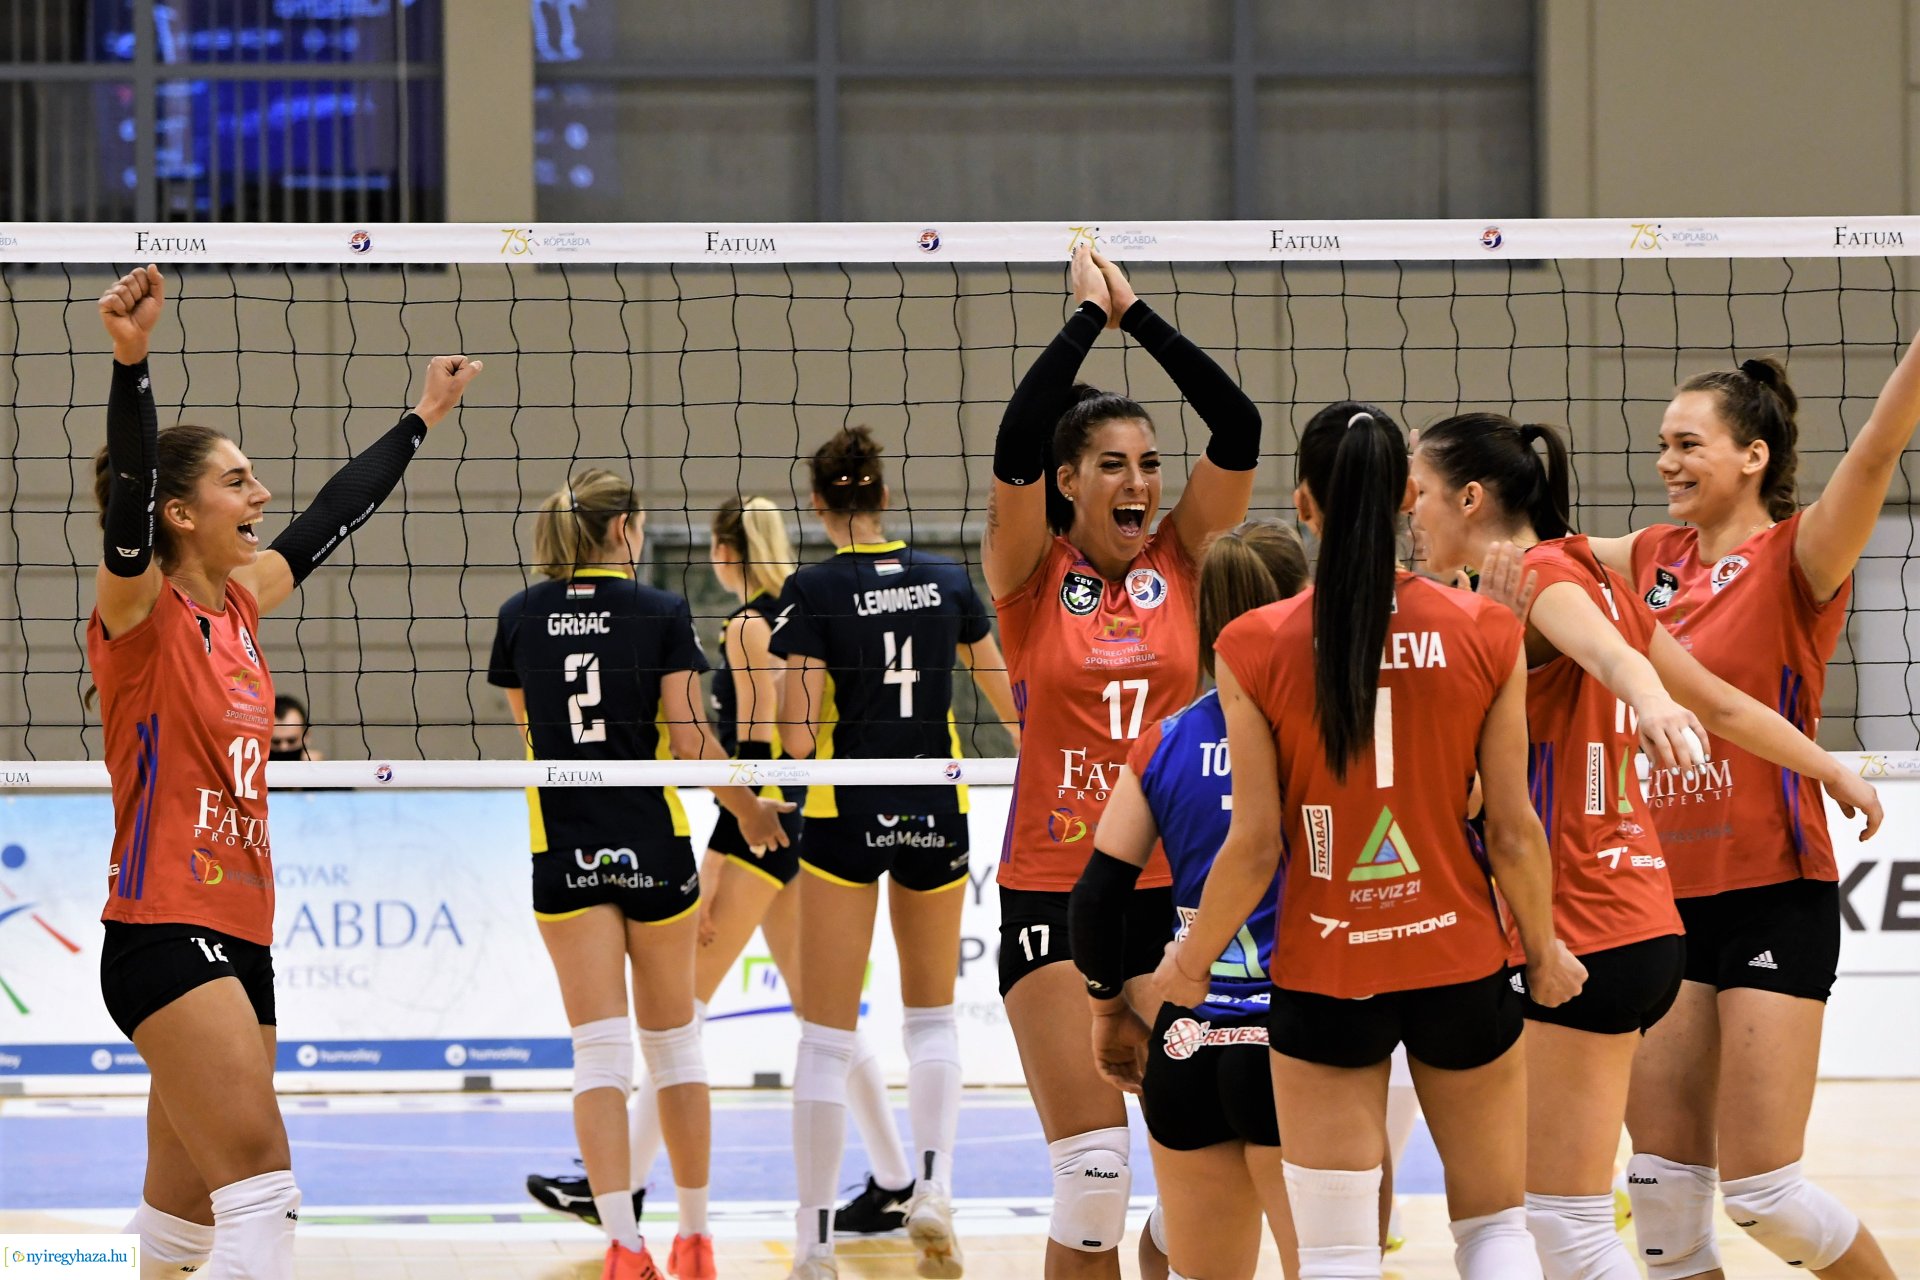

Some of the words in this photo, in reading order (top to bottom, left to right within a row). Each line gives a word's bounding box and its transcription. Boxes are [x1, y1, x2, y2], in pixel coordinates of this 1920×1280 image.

[134, 231, 207, 251] FATUM
[705, 231, 776, 251] FATUM
[1269, 229, 1340, 249] FATUM
[1834, 226, 1904, 246] FATUM
[1074, 576, 1093, 586] CEV
[853, 582, 942, 616] LEMMENS
[547, 611, 611, 636] GRBAC
[1085, 653, 1156, 665] SPORTCENTRUM
[883, 631, 920, 718] 4
[564, 653, 607, 744] 2
[1102, 678, 1149, 740] 17
[228, 736, 261, 800] 12
[546, 766, 603, 782] FATUM
[866, 831, 895, 848] Led
[897, 831, 945, 848] Média
[1312, 808, 1327, 874] STRABAG
[566, 871, 599, 888] Led
[602, 871, 654, 888] Média
[1406, 879, 1420, 896] 21
[272, 900, 464, 949] ABDA
[1348, 911, 1457, 944] BESTRONG
[1018, 924, 1050, 962] 17
[1084, 1167, 1119, 1178] MIKASA
